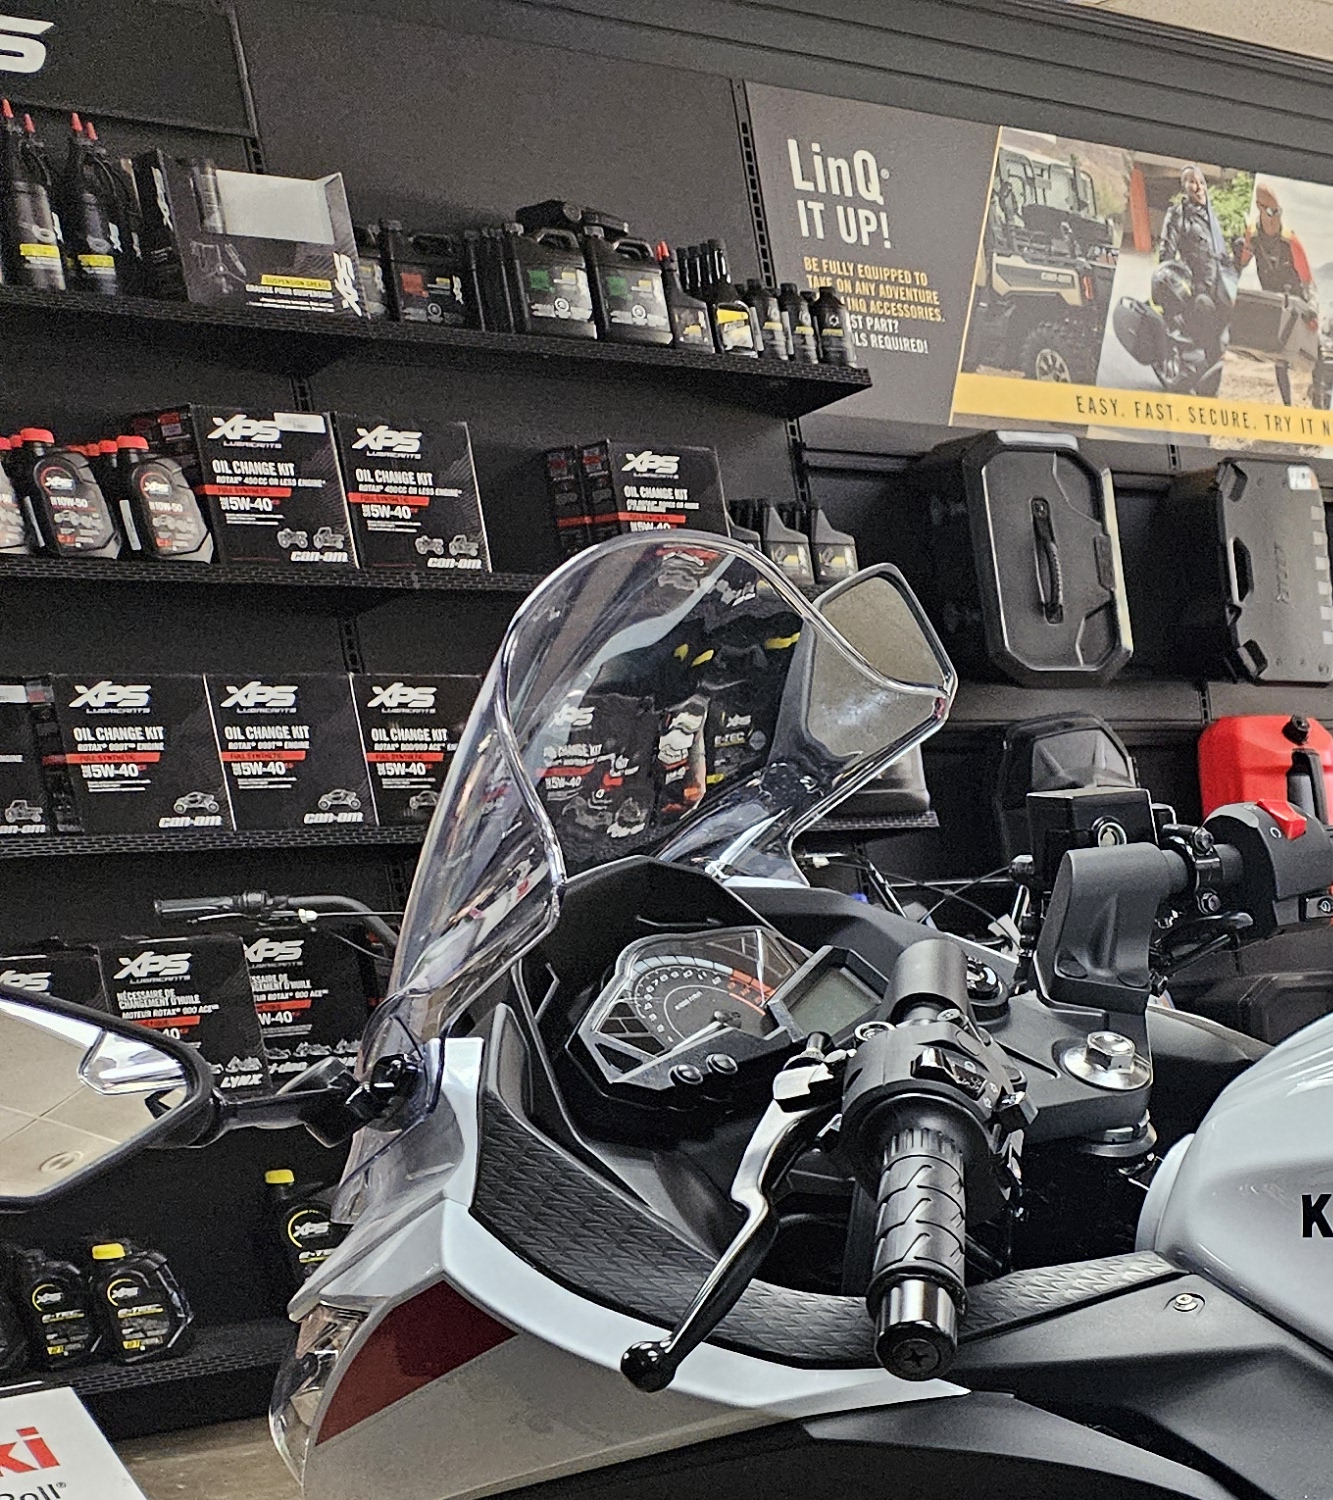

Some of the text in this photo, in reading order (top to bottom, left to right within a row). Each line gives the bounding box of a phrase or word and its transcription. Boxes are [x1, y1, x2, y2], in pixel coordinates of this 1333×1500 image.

[797, 200, 892, 249] IT UP!
[803, 256, 928, 286] BE FULLY EQUIPPED TO
[836, 279, 852, 294] ON
[855, 281, 877, 297] ANY
[879, 284, 940, 305] ADVENTURE
[870, 301, 946, 323] ACCESSORIES.
[866, 316, 899, 334] PART?
[870, 334, 929, 355] REQUIRED!
[1076, 395, 1126, 418] EASY.
[1135, 401, 1180, 422] FAST.
[1188, 406, 1257, 430] SECURE.
[1265, 414, 1292, 433] TRY
[1300, 417, 1314, 434] IT
[207, 414, 283, 442] XPS
[352, 425, 422, 452] XPS
[212, 460, 295, 477] OIL CHANGE KIT
[621, 451, 680, 474] XPS
[356, 469, 433, 486] OIL CHANGE KIT
[624, 485, 688, 501] OIL CHANGE KIT
[290, 551, 349, 563] can-am
[427, 557, 482, 570] can-am
[69, 681, 151, 707] XPS
[220, 681, 298, 707] XPS
[368, 682, 437, 708] XPS
[73, 726, 164, 741] OIL CHANGE KIT
[224, 726, 309, 740] OIL CHANGE KIT
[371, 728, 448, 741] OIL CHANGE KIT
[159, 815, 222, 828] can-am
[304, 812, 363, 825] can-am
[114, 951, 192, 980] XPS
[118, 994, 201, 1010] CHANGEMENT D'HUILE
[162, 989, 176, 999] DE
[259, 1012, 293, 1026] W-40
